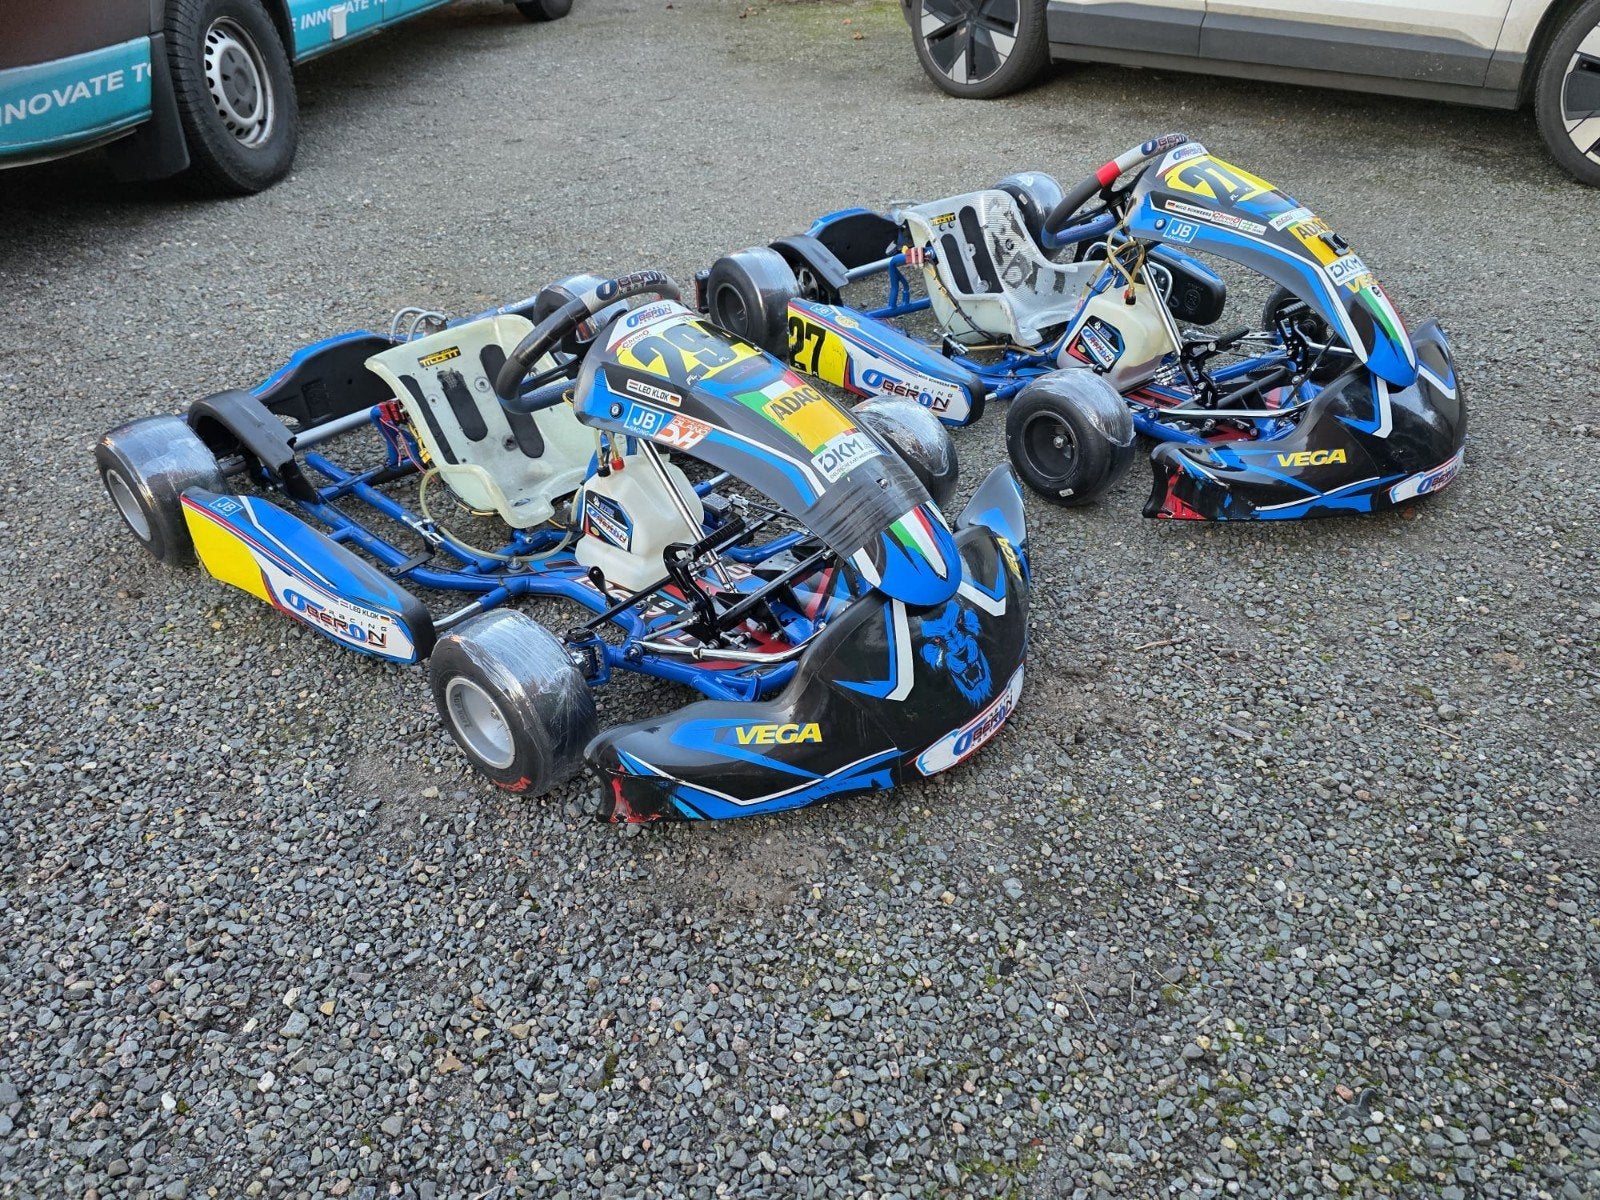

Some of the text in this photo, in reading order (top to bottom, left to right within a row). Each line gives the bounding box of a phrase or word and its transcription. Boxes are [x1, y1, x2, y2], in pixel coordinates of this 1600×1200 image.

[0, 70, 124, 127] NNOVATE
[1171, 224, 1191, 238] JB
[1329, 257, 1364, 278] DKM
[631, 323, 738, 387] 29
[788, 316, 827, 377] 27
[638, 384, 670, 401] LEO KLOK
[770, 387, 821, 421] ADAC
[862, 369, 950, 412] OBERON
[633, 410, 656, 429] JB
[818, 438, 864, 473] DKM
[1277, 448, 1348, 467] VEGA
[217, 501, 237, 512] JB
[283, 588, 388, 649] OBERON
[736, 722, 823, 745] VEGA
